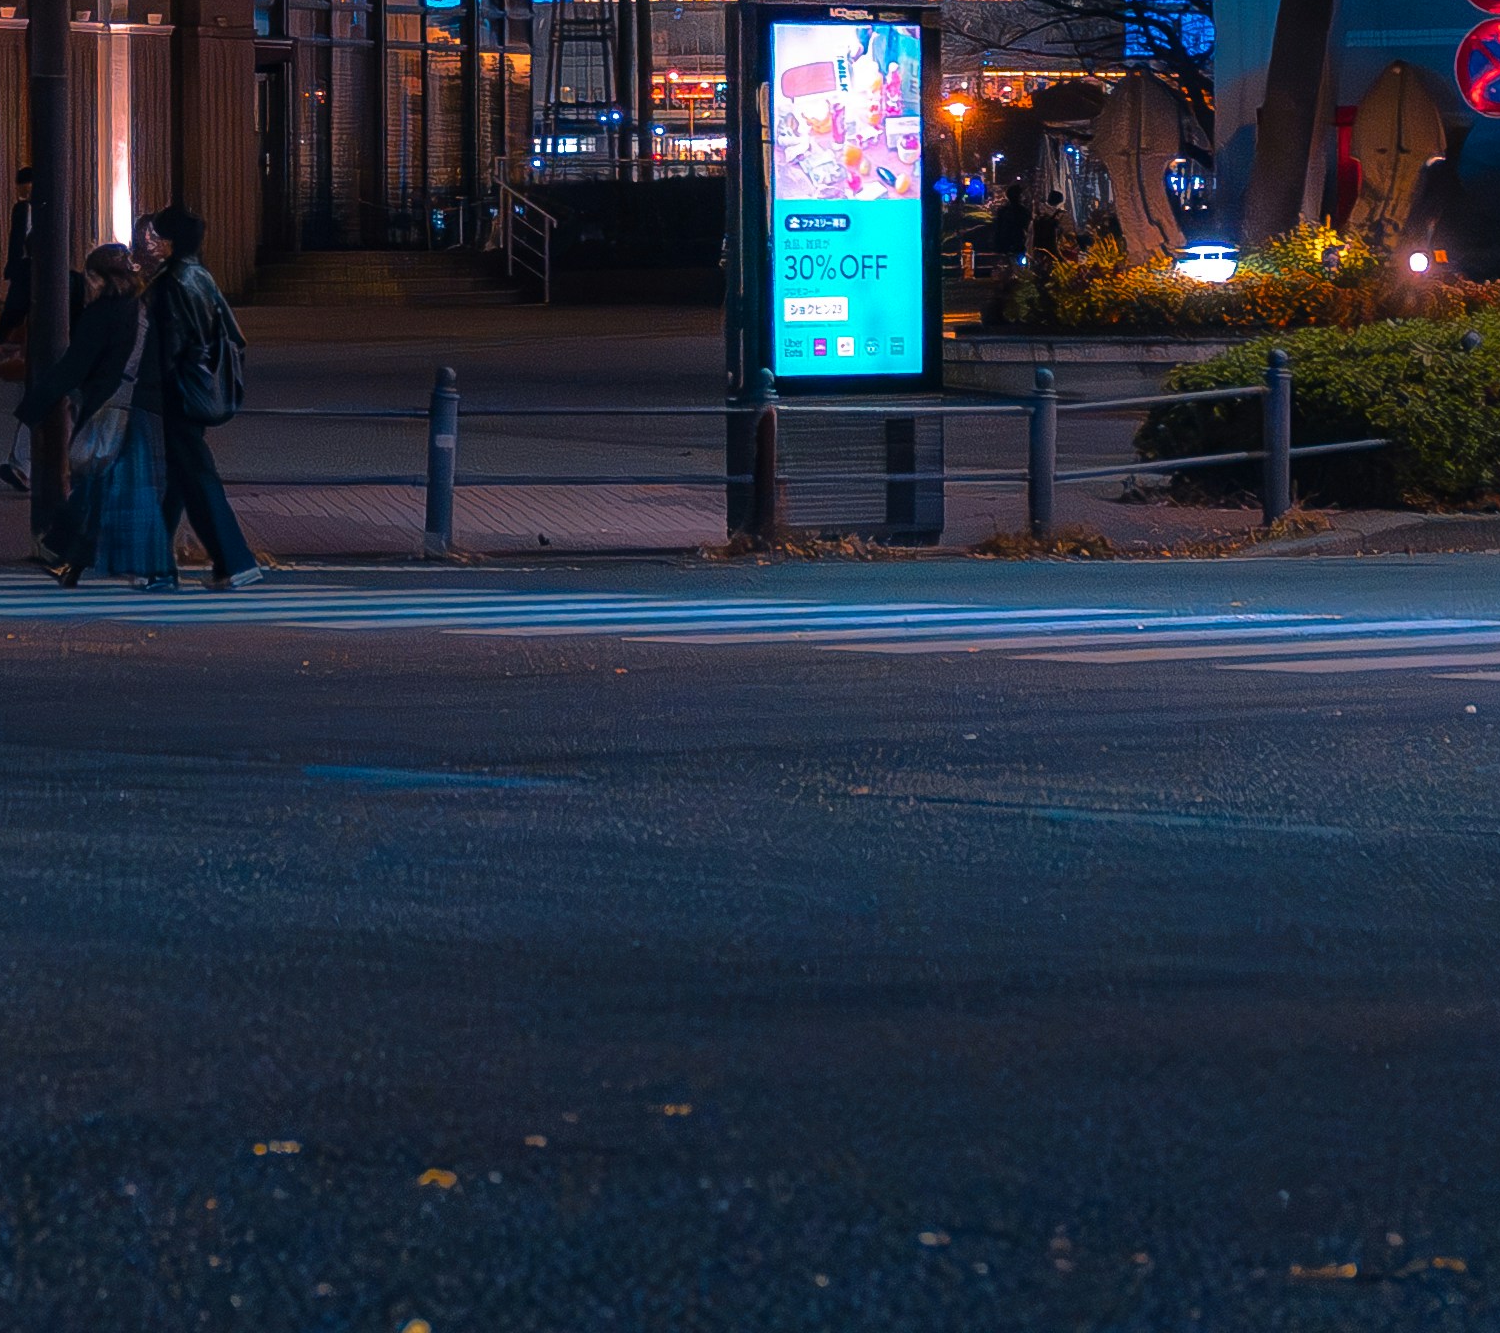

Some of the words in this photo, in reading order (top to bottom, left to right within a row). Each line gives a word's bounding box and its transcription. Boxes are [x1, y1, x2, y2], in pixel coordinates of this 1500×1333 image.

[836, 59, 849, 92] MILK
[784, 254, 888, 280] 30%OFF
[784, 338, 803, 348] Uber
